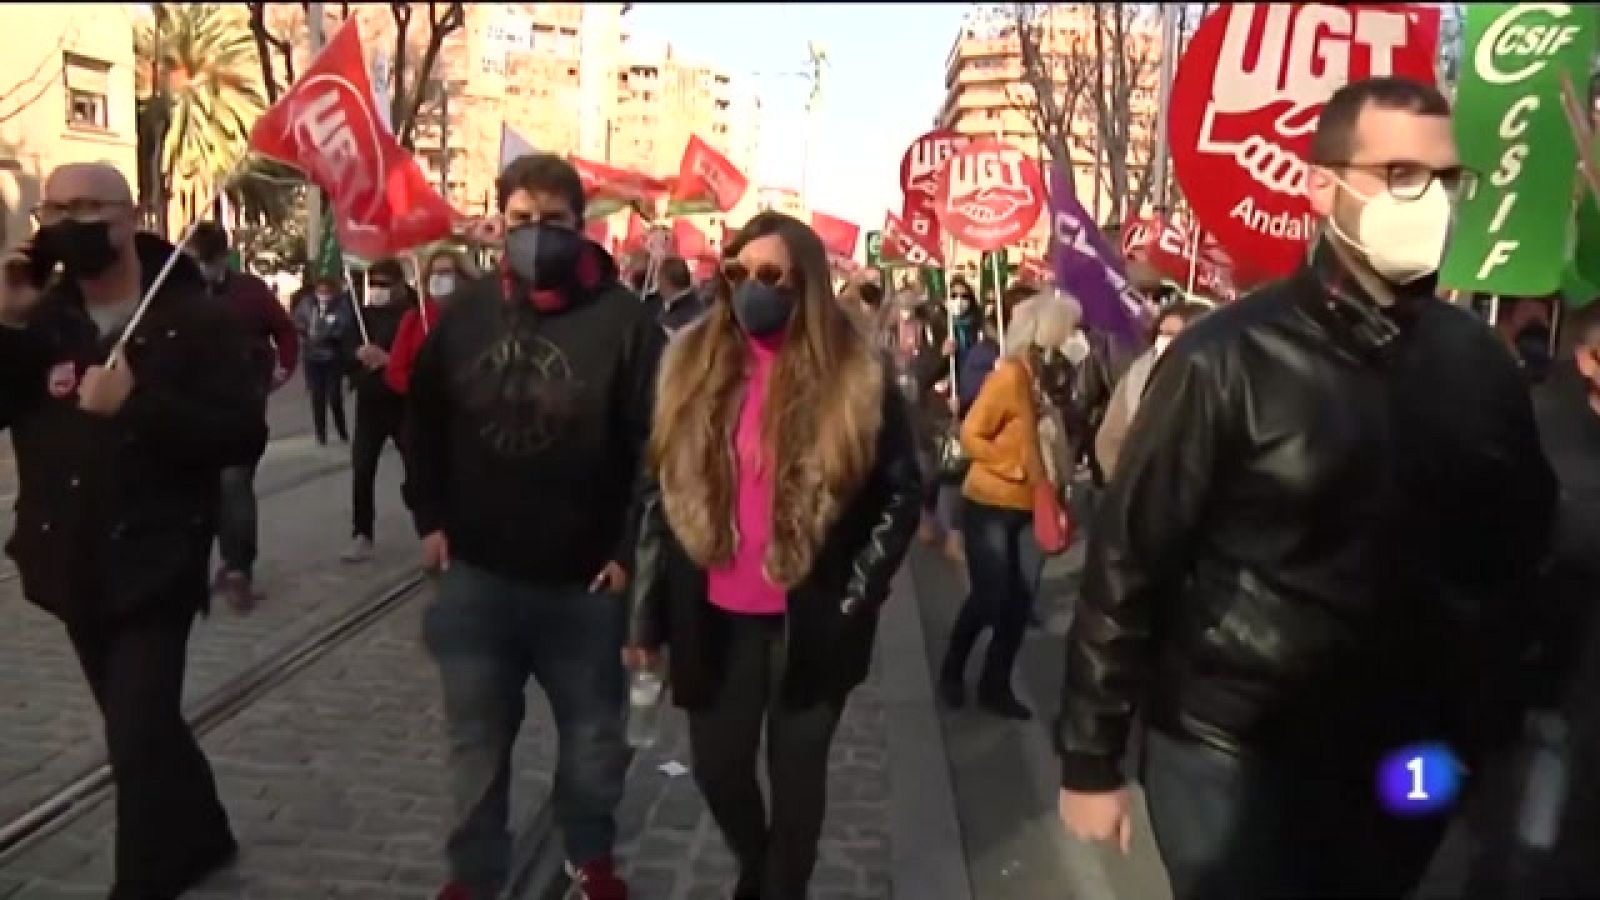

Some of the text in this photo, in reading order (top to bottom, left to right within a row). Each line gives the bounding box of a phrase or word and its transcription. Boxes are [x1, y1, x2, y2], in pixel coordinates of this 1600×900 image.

[1213, 4, 1407, 112] UGT
[949, 150, 1024, 196] UGT
[1230, 195, 1315, 241] Andal
